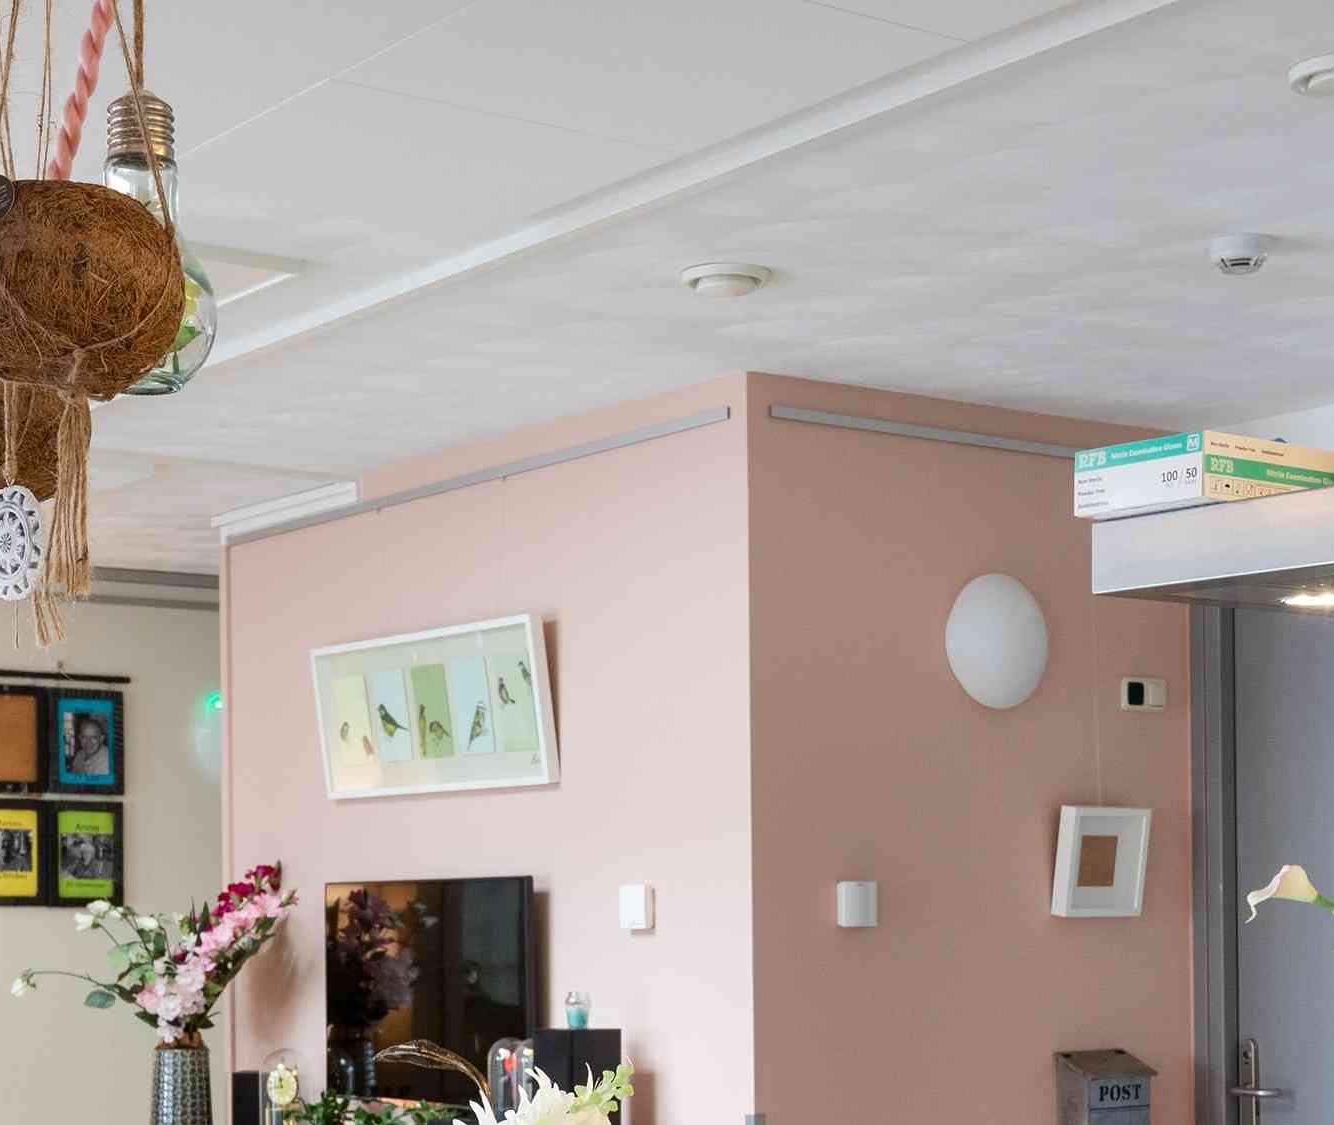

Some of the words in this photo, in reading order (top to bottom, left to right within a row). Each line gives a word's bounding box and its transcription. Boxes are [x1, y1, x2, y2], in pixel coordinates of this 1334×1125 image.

[1078, 449, 1107, 468] RFB
[1210, 457, 1234, 473] RFB
[1161, 470, 1179, 483] 100
[1186, 467, 1198, 479] 50
[1099, 1084, 1142, 1102] POST
